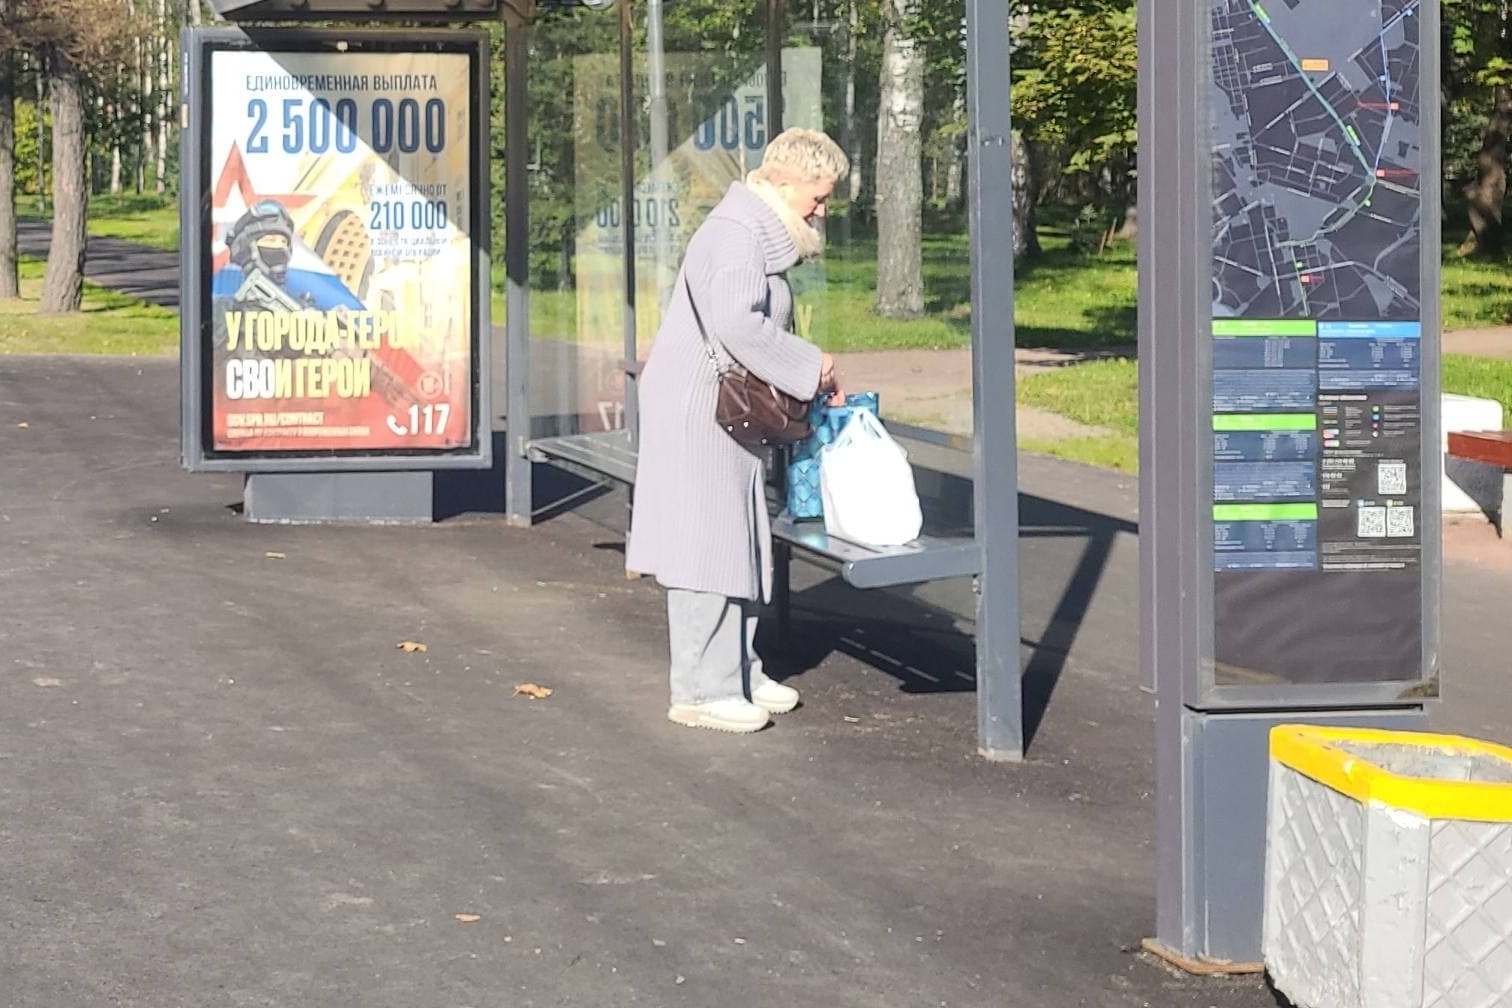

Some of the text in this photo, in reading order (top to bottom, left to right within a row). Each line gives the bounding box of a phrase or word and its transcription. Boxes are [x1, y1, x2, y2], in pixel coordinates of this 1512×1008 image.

[246, 75, 438, 92] ЕДИНОВРЕМЕННАЯ ВЫПЛАТА
[246, 98, 446, 154] 2 500 000
[370, 200, 447, 229] 210 000
[225, 310, 420, 355] У ГОРОДА-ГЕРО
[226, 358, 372, 400] СВОИ ГЕРОИ
[408, 403, 450, 437] 117
